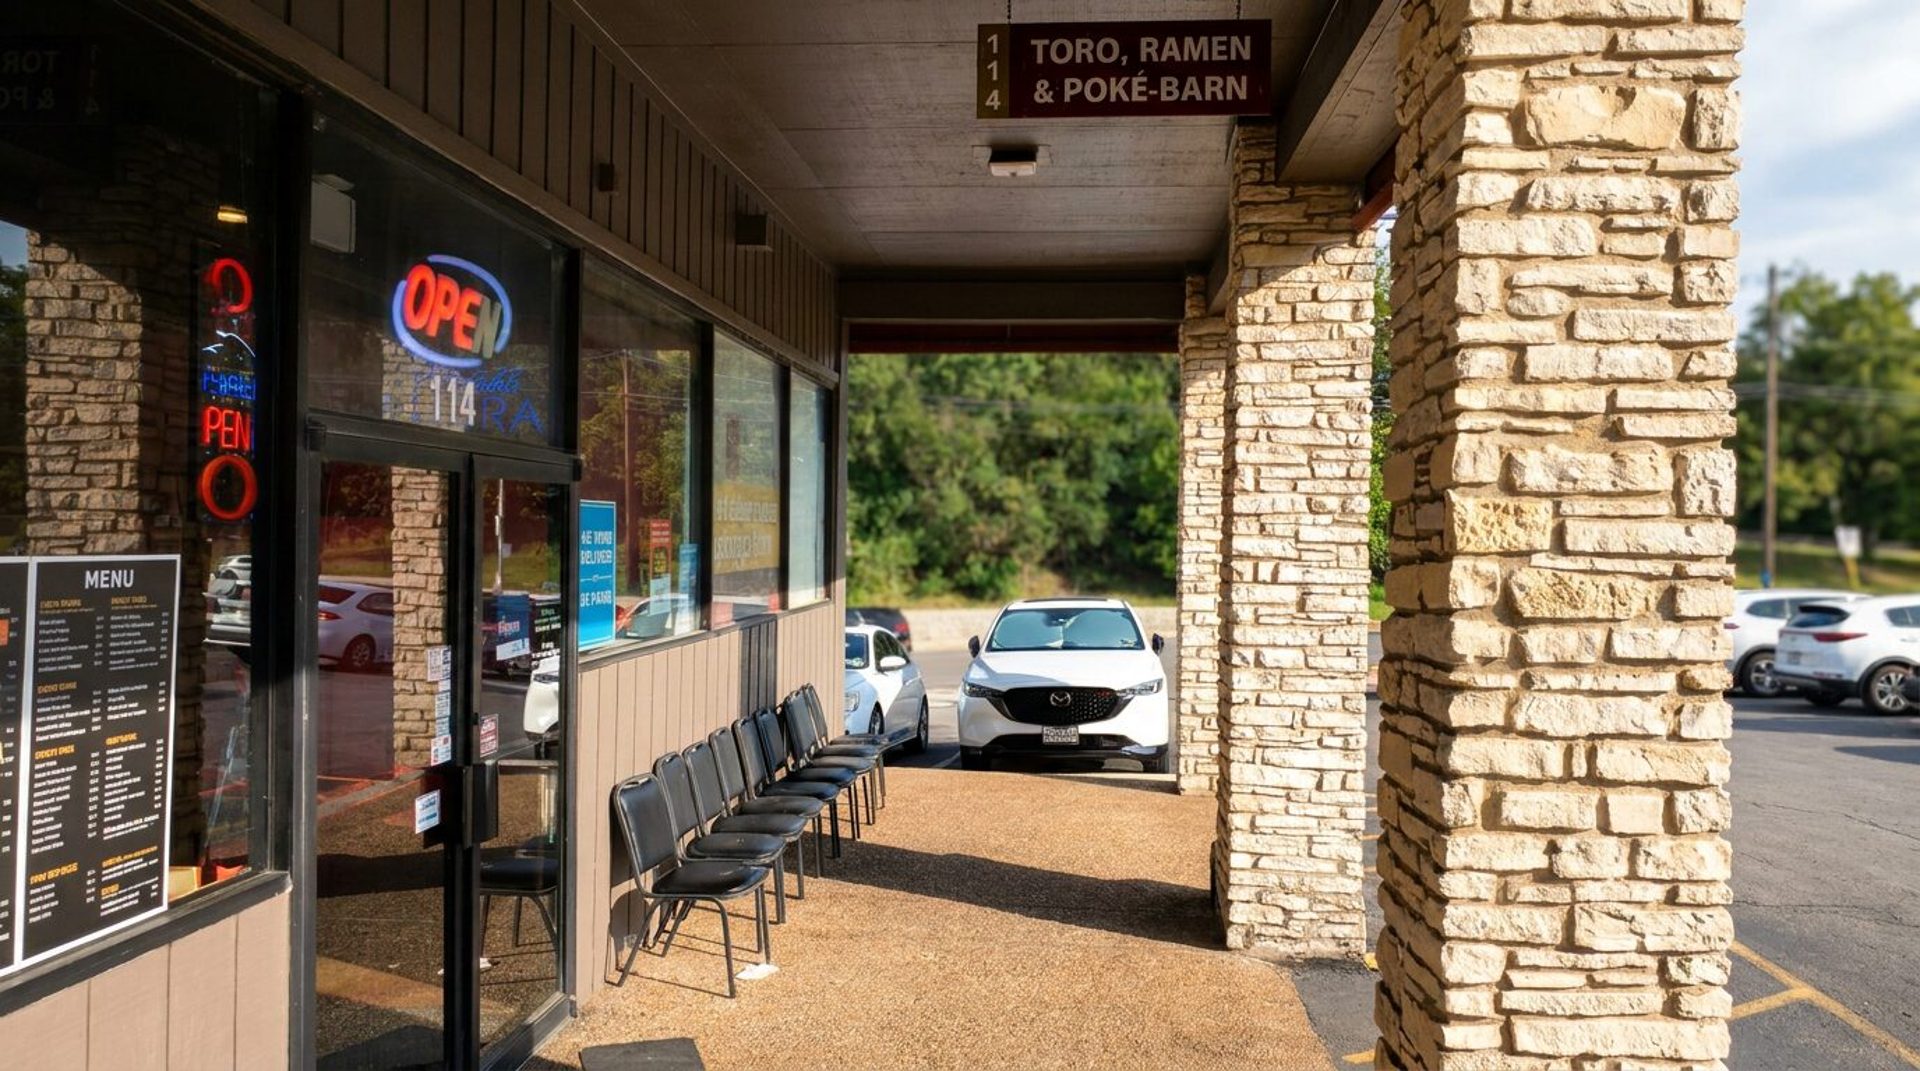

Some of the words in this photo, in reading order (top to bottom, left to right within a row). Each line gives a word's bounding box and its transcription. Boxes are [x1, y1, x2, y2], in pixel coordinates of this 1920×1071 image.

[1031, 37, 1128, 66] TORO,
[1140, 35, 1251, 62] RAMEN
[1034, 79, 1054, 103] &
[1064, 69, 1247, 102] POKÉ-BARN
[403, 264, 501, 359] OPEN
[430, 375, 476, 427] 114
[84, 569, 134, 589] MENU
